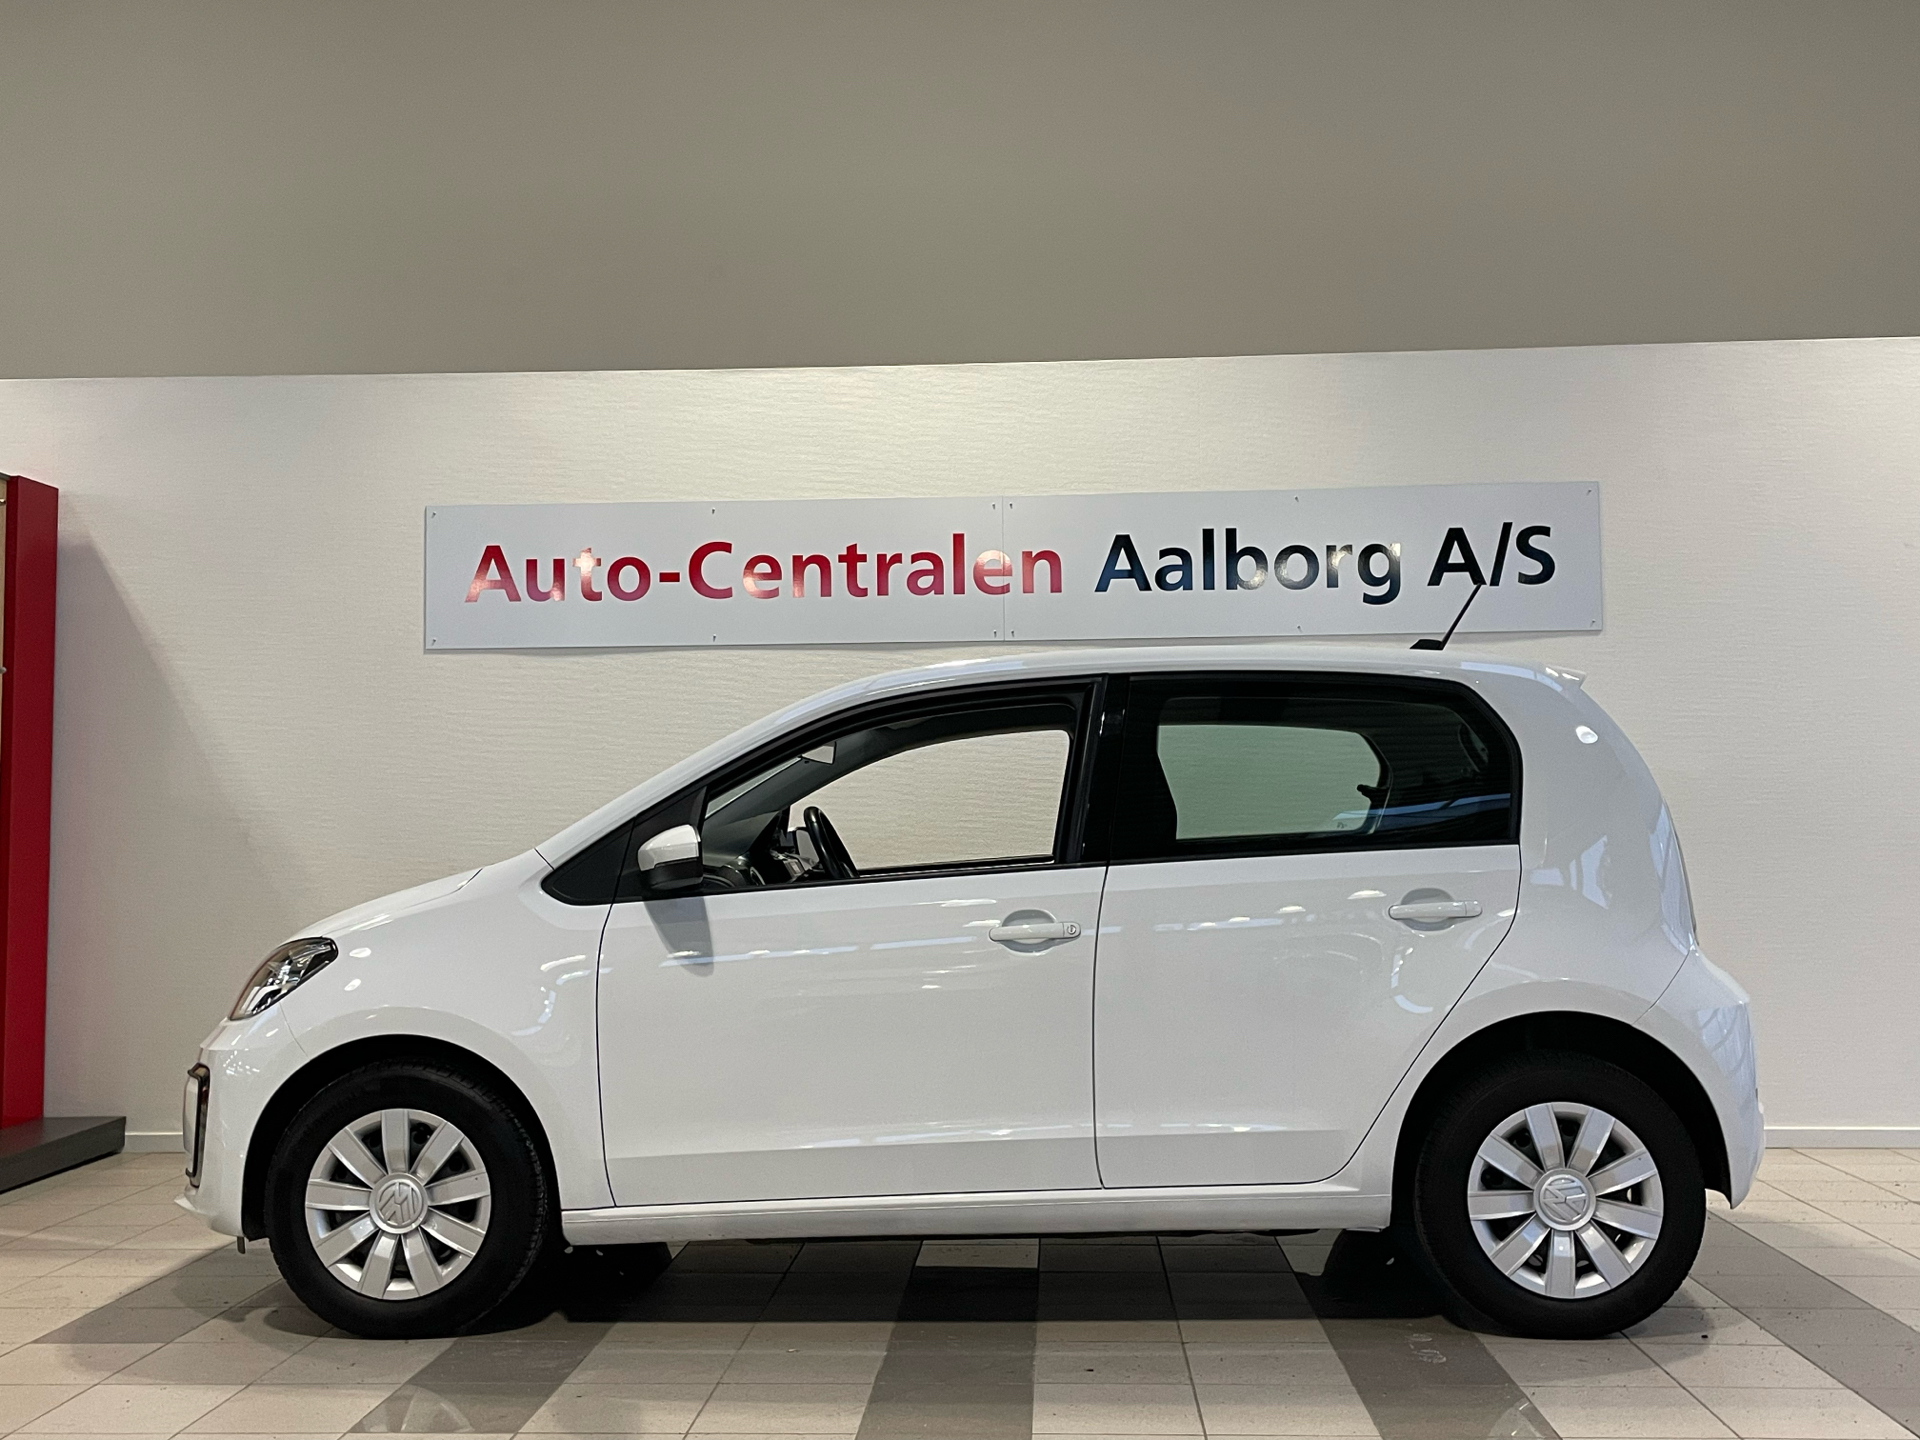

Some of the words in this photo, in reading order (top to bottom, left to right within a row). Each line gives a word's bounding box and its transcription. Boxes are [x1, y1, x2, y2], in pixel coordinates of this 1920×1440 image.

[465, 533, 1063, 603] Auto-Centralen
[1094, 527, 1402, 606] Aalborg
[1427, 521, 1557, 588] A/S
